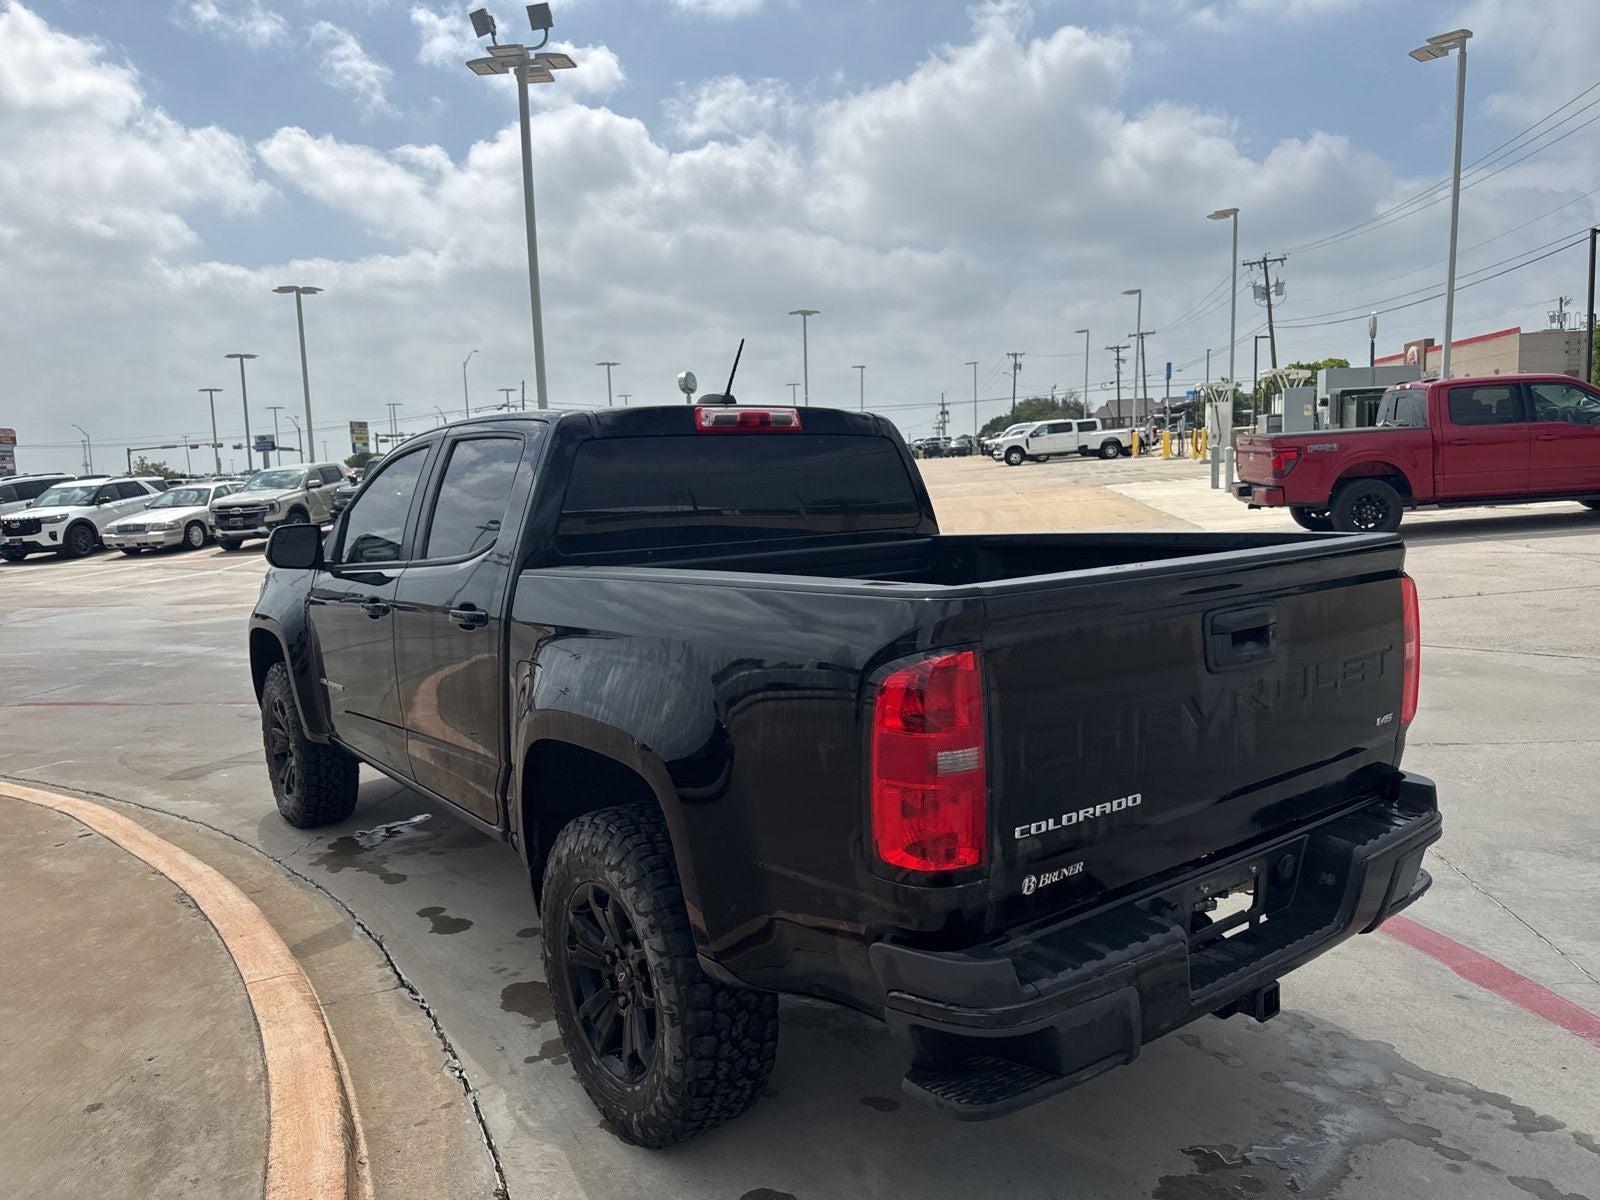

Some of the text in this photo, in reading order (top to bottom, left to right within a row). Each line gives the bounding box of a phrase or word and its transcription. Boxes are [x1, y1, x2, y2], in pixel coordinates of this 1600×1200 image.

[1376, 712, 1394, 727] V6
[1014, 793, 1142, 839] COLORADO
[1038, 862, 1084, 889] BRUNER
